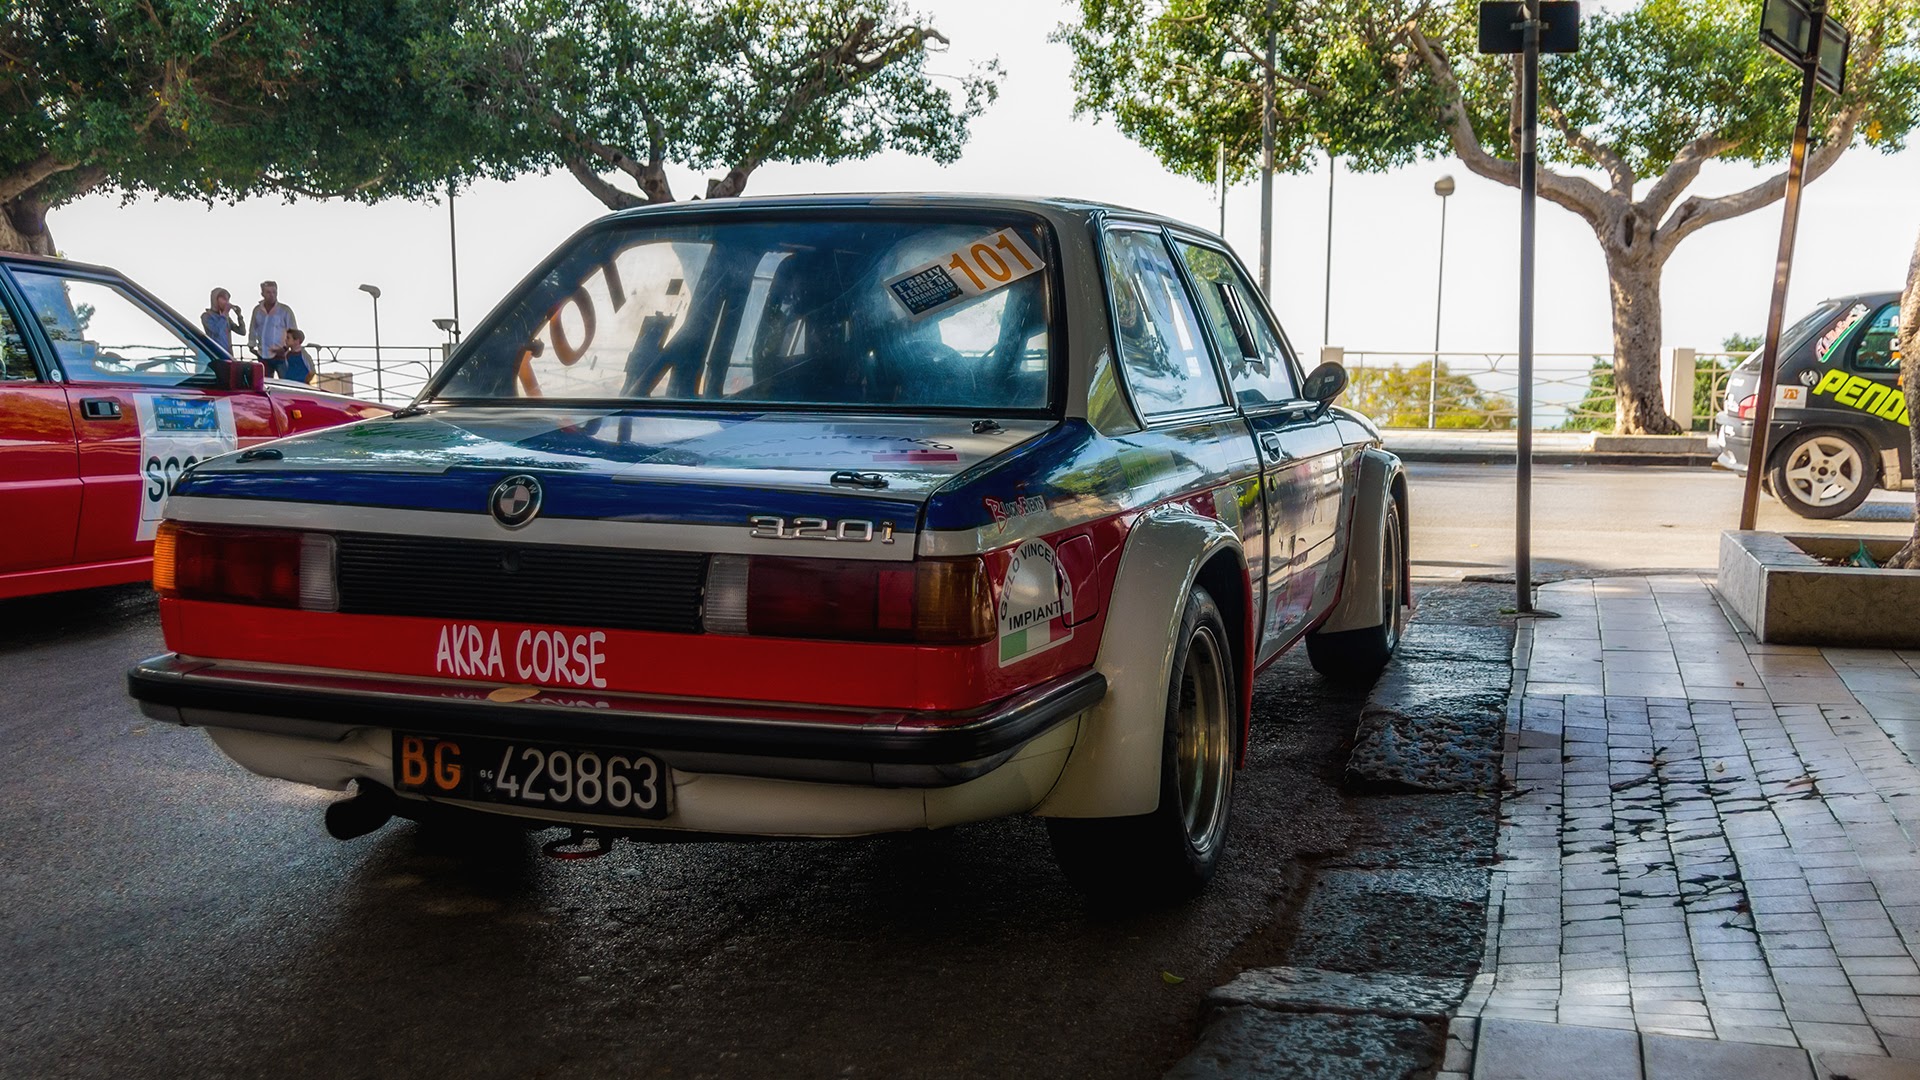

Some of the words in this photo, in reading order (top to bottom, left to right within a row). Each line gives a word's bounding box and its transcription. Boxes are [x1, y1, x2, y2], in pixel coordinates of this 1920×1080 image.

[949, 233, 1035, 291] 101
[900, 279, 936, 300] TERRE
[935, 274, 949, 286] DI
[905, 266, 942, 289] RALLY
[905, 280, 954, 305] PIRANDELLO
[1812, 368, 1910, 427] PEND
[733, 448, 929, 459] IMPIANTI
[797, 435, 954, 450] VINCENZO
[500, 478, 538, 494] BMW
[749, 515, 895, 544] 320i
[1020, 543, 1070, 597] VINCENO
[436, 623, 505, 678] AKRA
[515, 629, 607, 688] CORSE
[402, 735, 461, 790] BG
[496, 745, 658, 810] 429863
